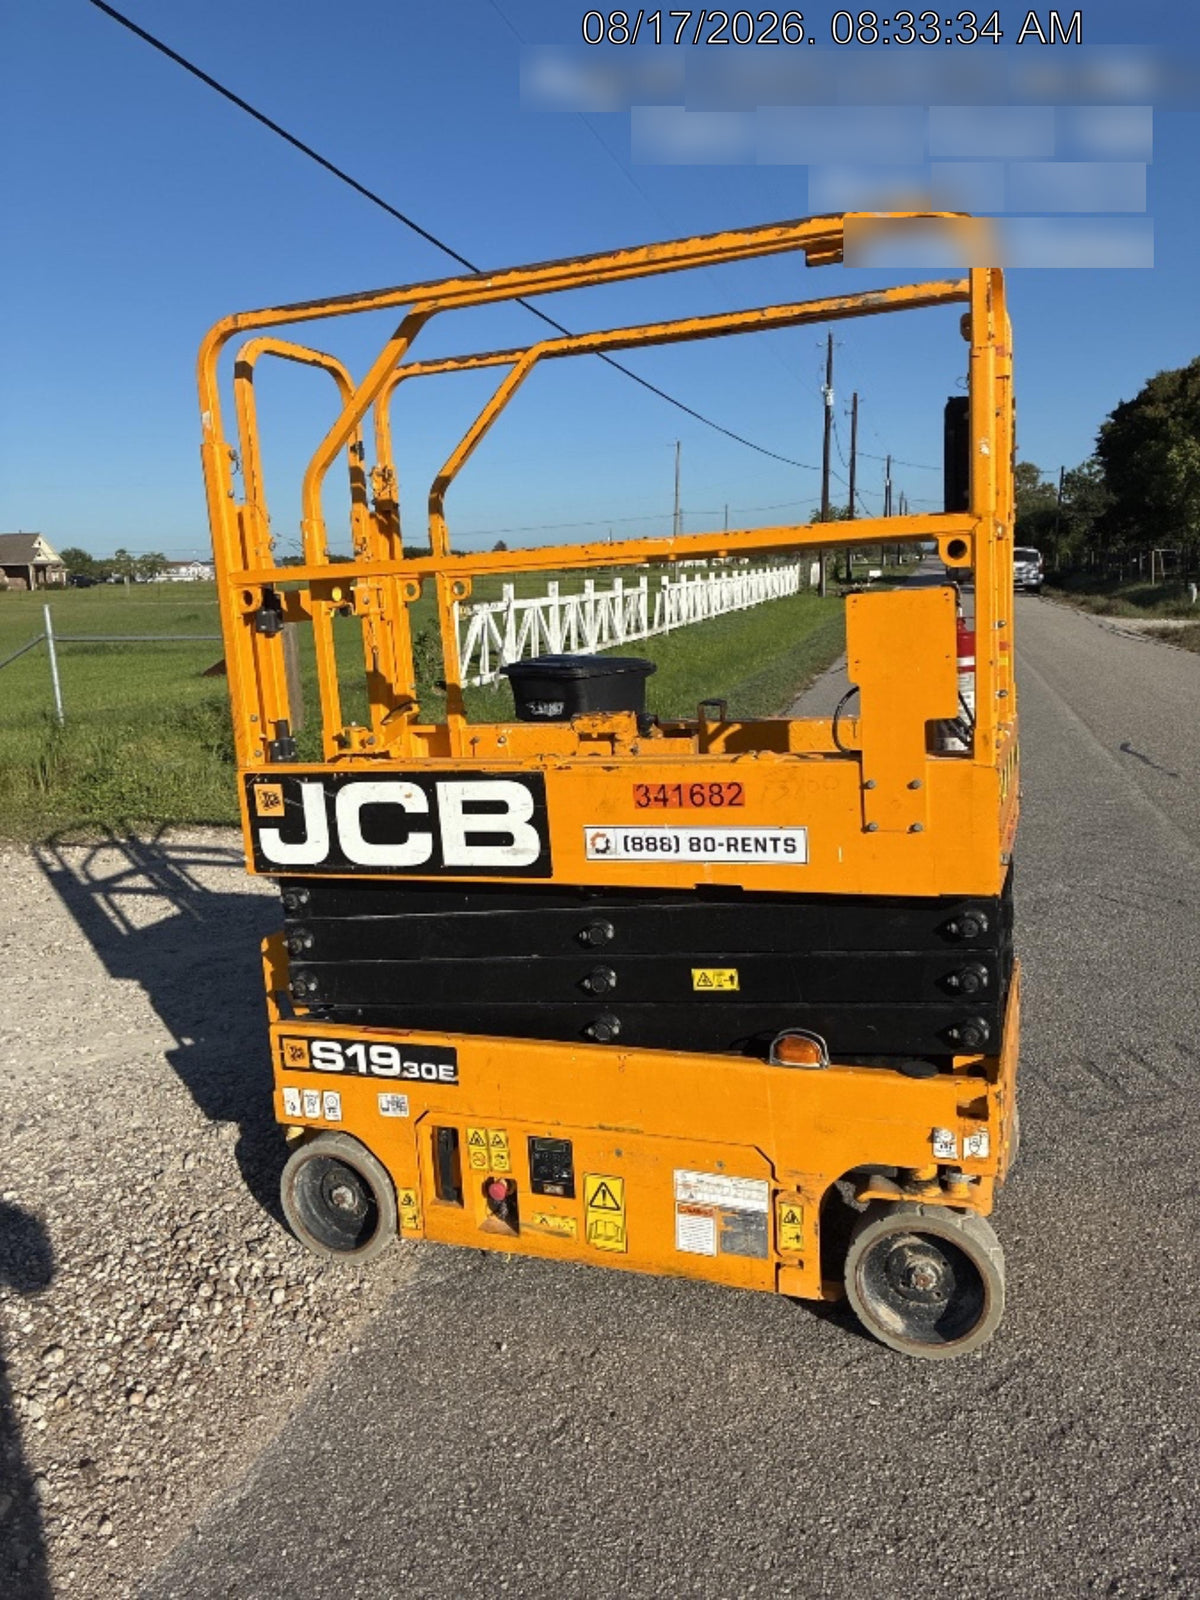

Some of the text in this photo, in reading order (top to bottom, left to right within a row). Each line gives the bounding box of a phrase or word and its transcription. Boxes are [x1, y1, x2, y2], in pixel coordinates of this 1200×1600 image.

[635, 782, 743, 808] 341682
[258, 779, 541, 867] JCB
[624, 834, 797, 854] (888) 80-RENTS
